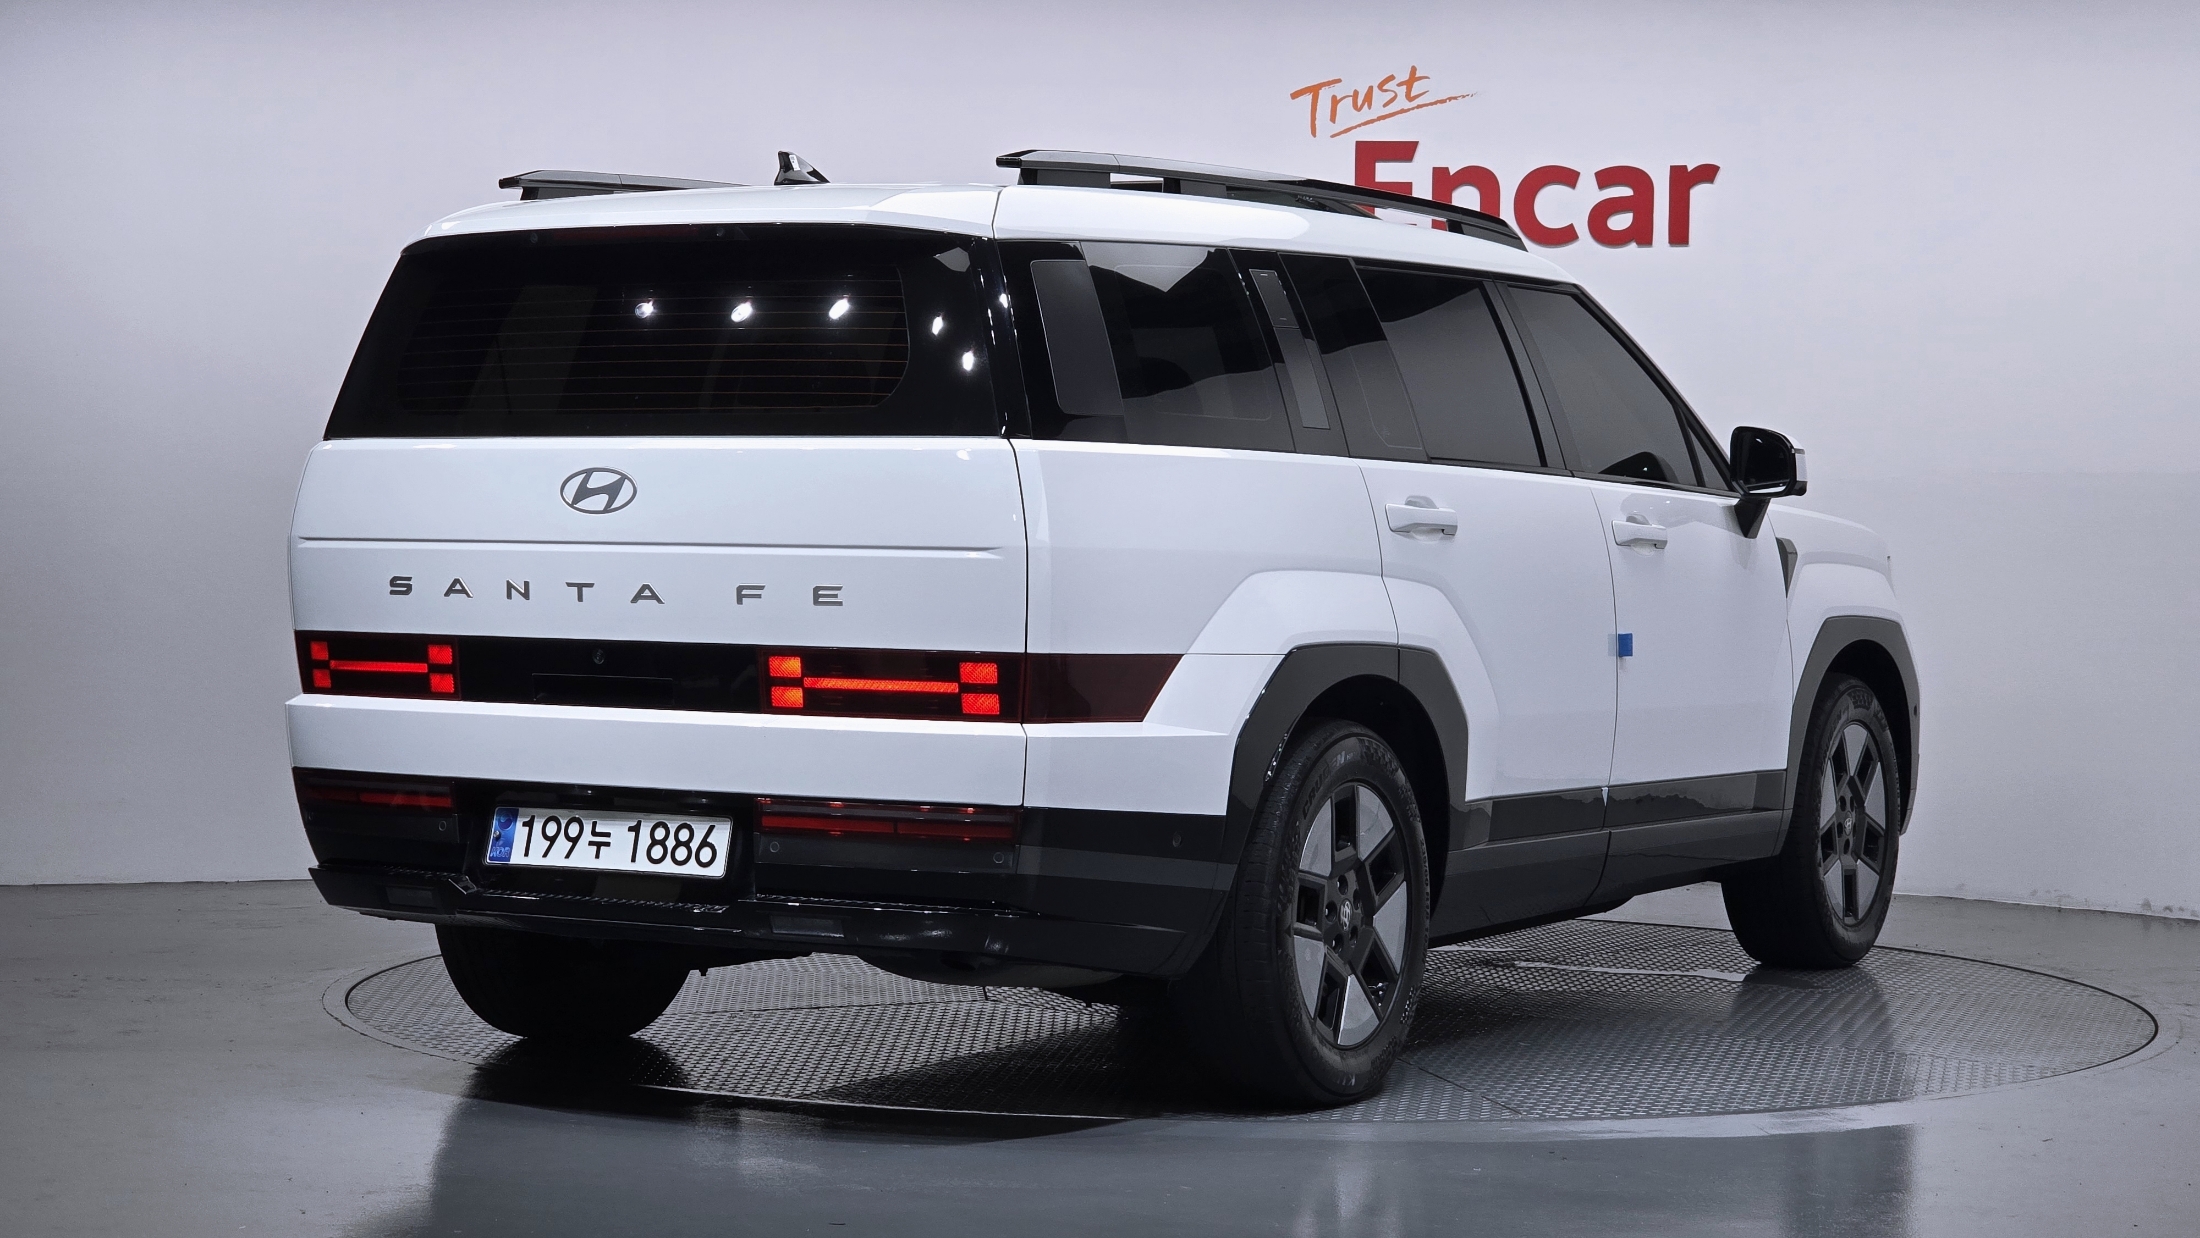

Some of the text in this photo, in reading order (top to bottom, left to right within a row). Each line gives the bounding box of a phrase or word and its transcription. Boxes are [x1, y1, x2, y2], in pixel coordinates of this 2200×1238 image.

[1290, 65, 1431, 138] Trust
[1355, 140, 1720, 248] Encar
[389, 575, 844, 607] SANTA FE
[521, 814, 718, 869] 199누 1886
